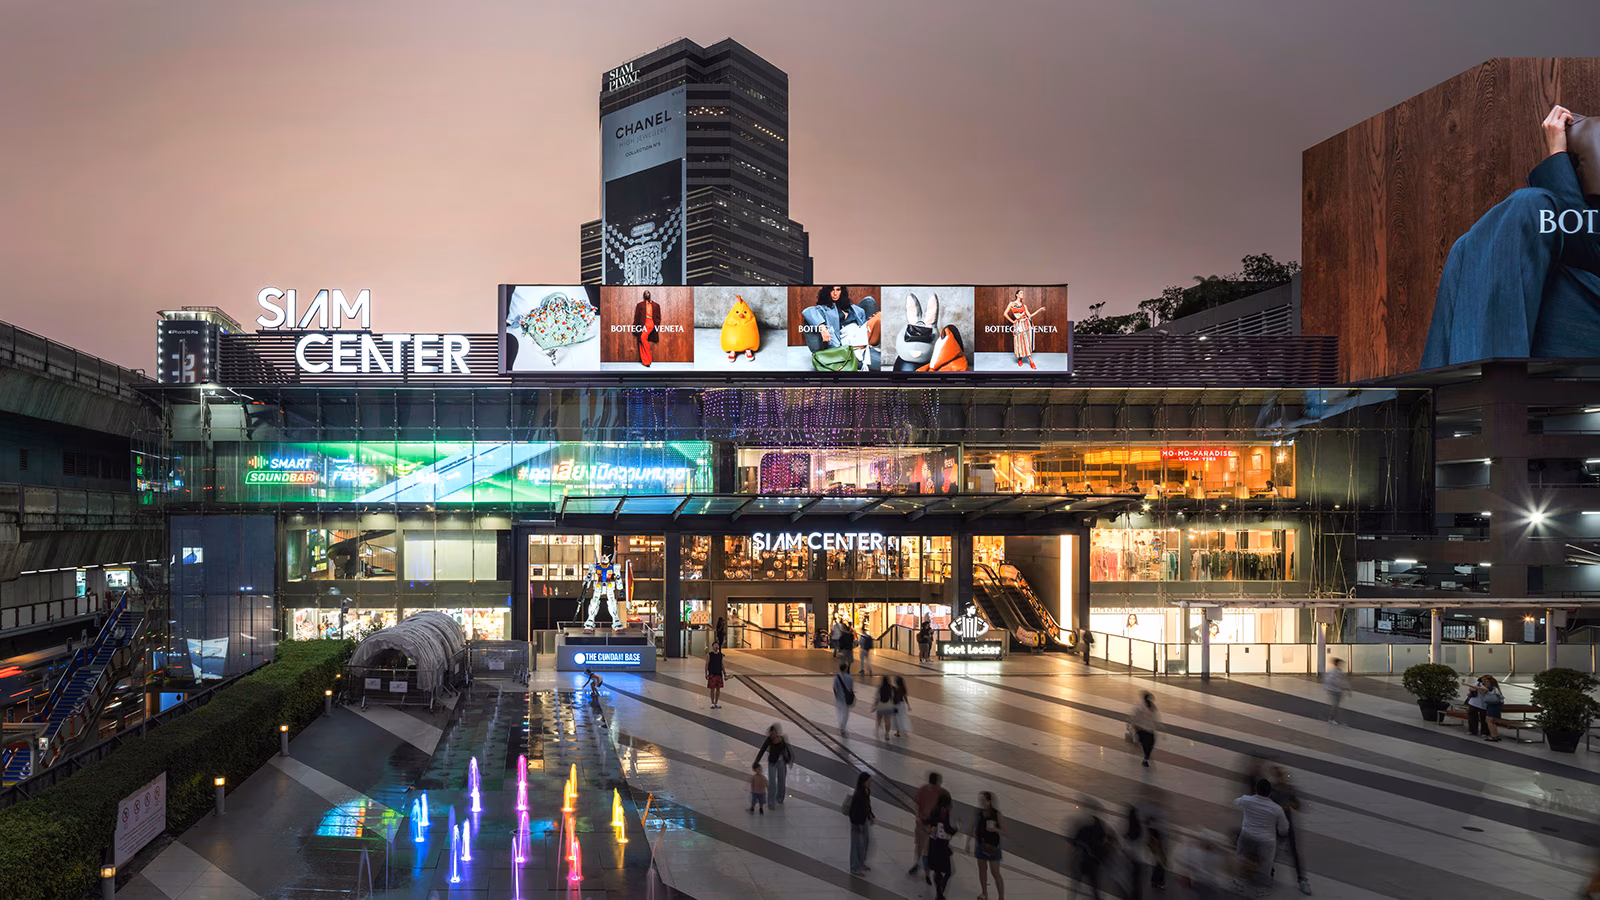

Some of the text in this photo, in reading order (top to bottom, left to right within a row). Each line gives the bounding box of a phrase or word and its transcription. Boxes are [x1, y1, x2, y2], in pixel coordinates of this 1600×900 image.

[609, 62, 634, 81] SIAM
[609, 70, 640, 93] PIWAT
[615, 110, 672, 140] CHANEL
[625, 144, 653, 158] COLLECTION
[1539, 209, 1598, 234] BOT
[256, 286, 371, 329] SIAM
[611, 325, 684, 333] BOTTEGA VENETA
[295, 333, 472, 374] CENTER
[270, 458, 312, 469] SMART
[250, 473, 313, 482] SOUNDBAR
[752, 531, 883, 551] SIAM CENTER
[585, 652, 641, 661] THE GUNDAM BASE
[943, 644, 1001, 655] Foot Locker
